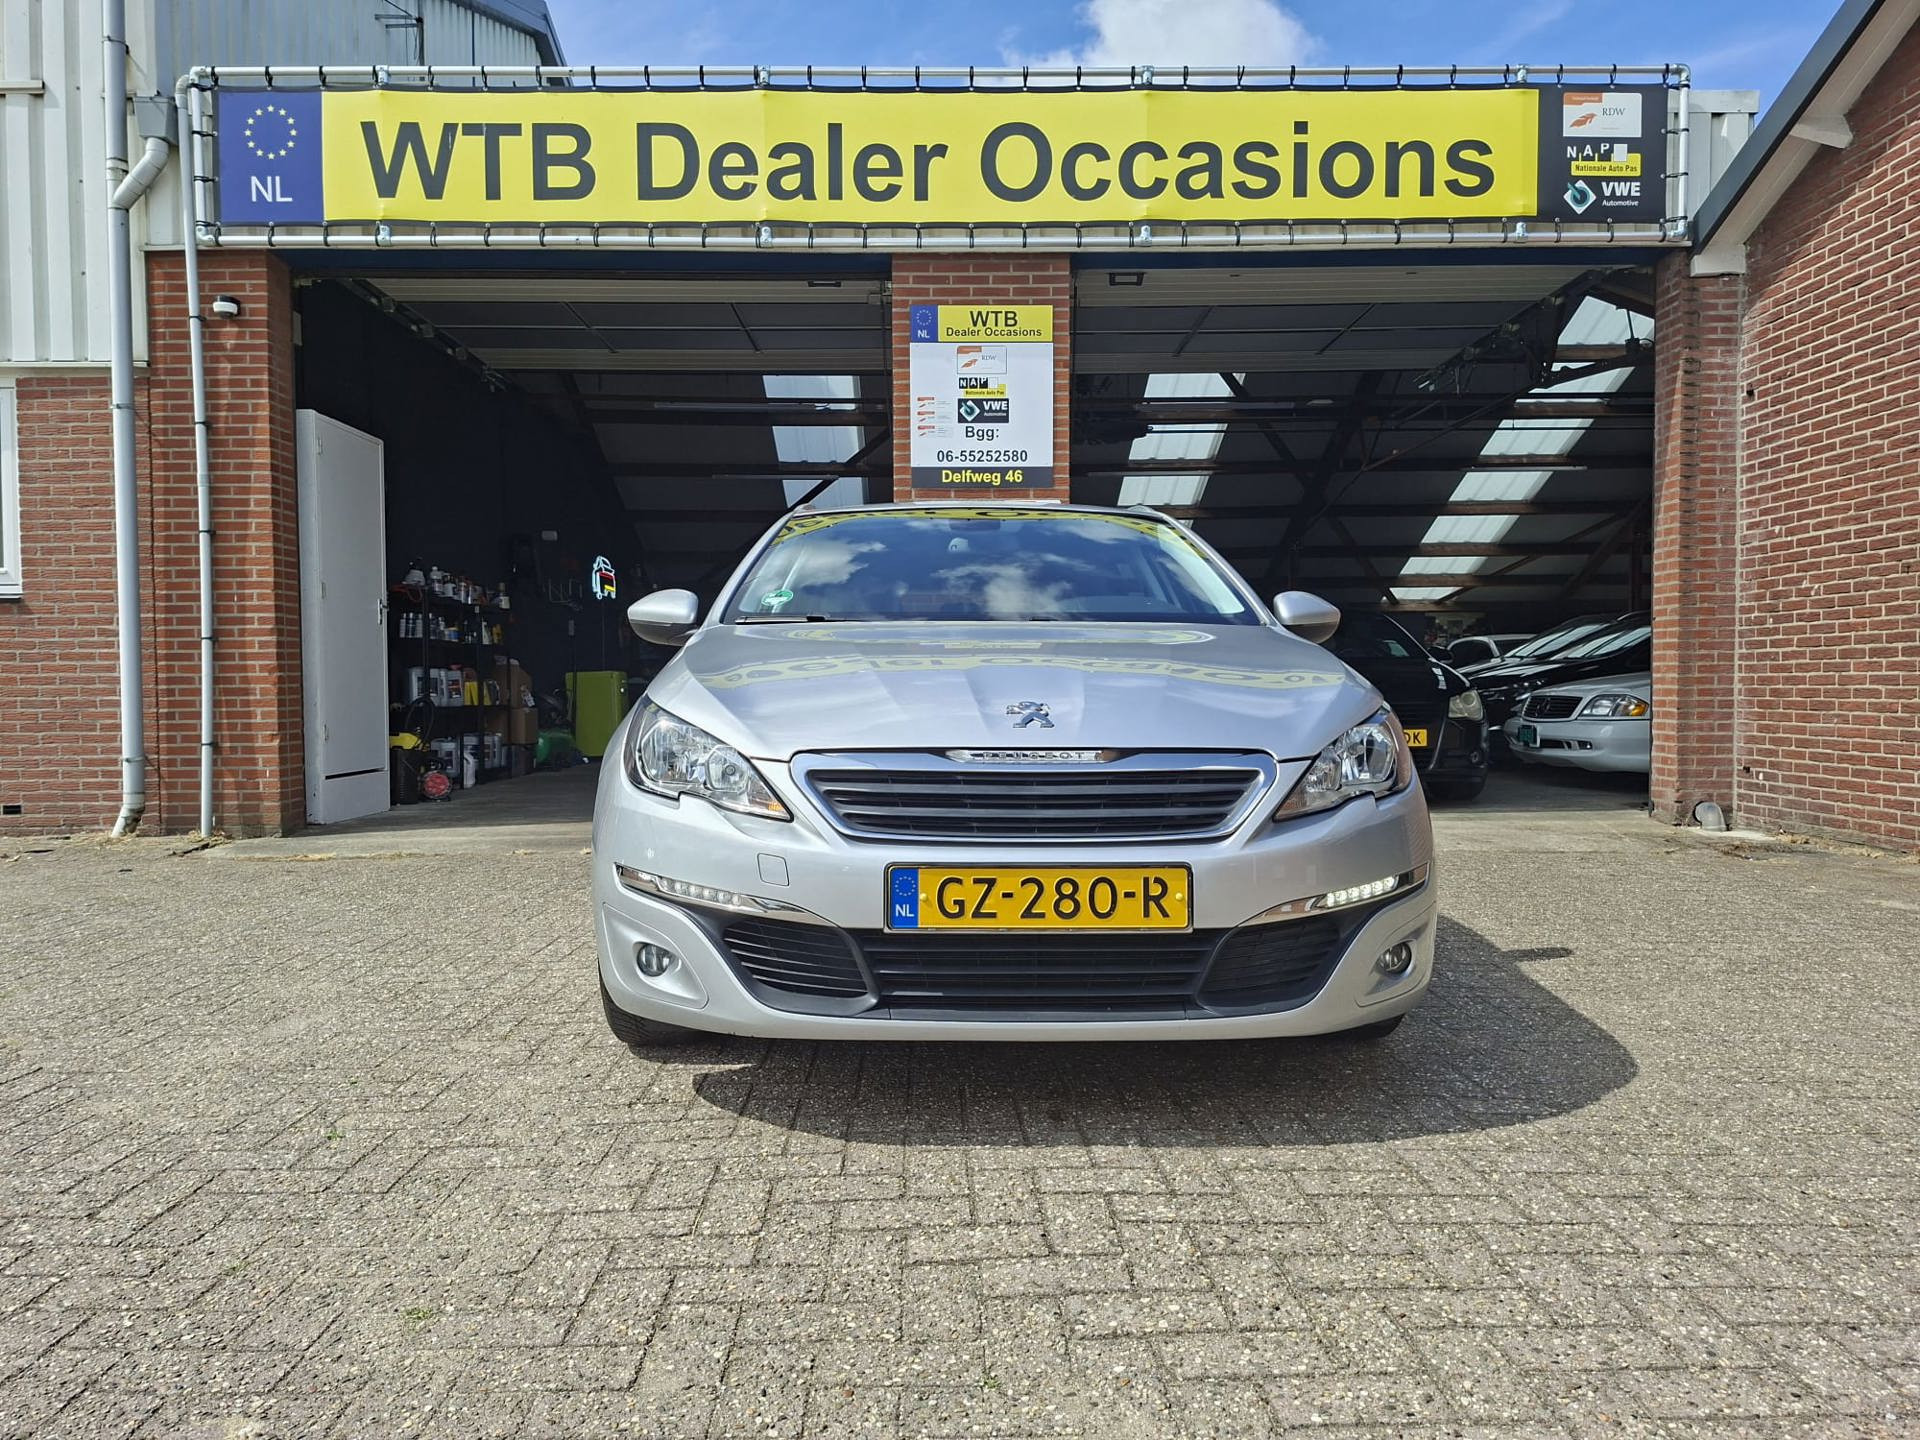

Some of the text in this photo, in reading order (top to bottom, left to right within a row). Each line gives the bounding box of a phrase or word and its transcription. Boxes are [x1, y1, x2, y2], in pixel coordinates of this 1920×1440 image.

[1602, 107, 1626, 116] RDW
[361, 120, 1495, 202] WTB Dealer Occasions
[1575, 164, 1638, 172] Nationale Auto Pas
[251, 176, 293, 203] NL
[1601, 182, 1641, 197] VWE
[970, 310, 1018, 327] WTB
[917, 330, 930, 338] NL
[946, 327, 1042, 337] Dealer Occasions
[983, 401, 1008, 410] VWE
[965, 425, 1000, 440] Bgg:
[936, 450, 1028, 463] 06-55252580
[941, 470, 1023, 484] Delfweg 46
[983, 751, 1086, 760] PEUGEOT
[936, 876, 1171, 920] GZ-280-R
[894, 904, 914, 917] NL
